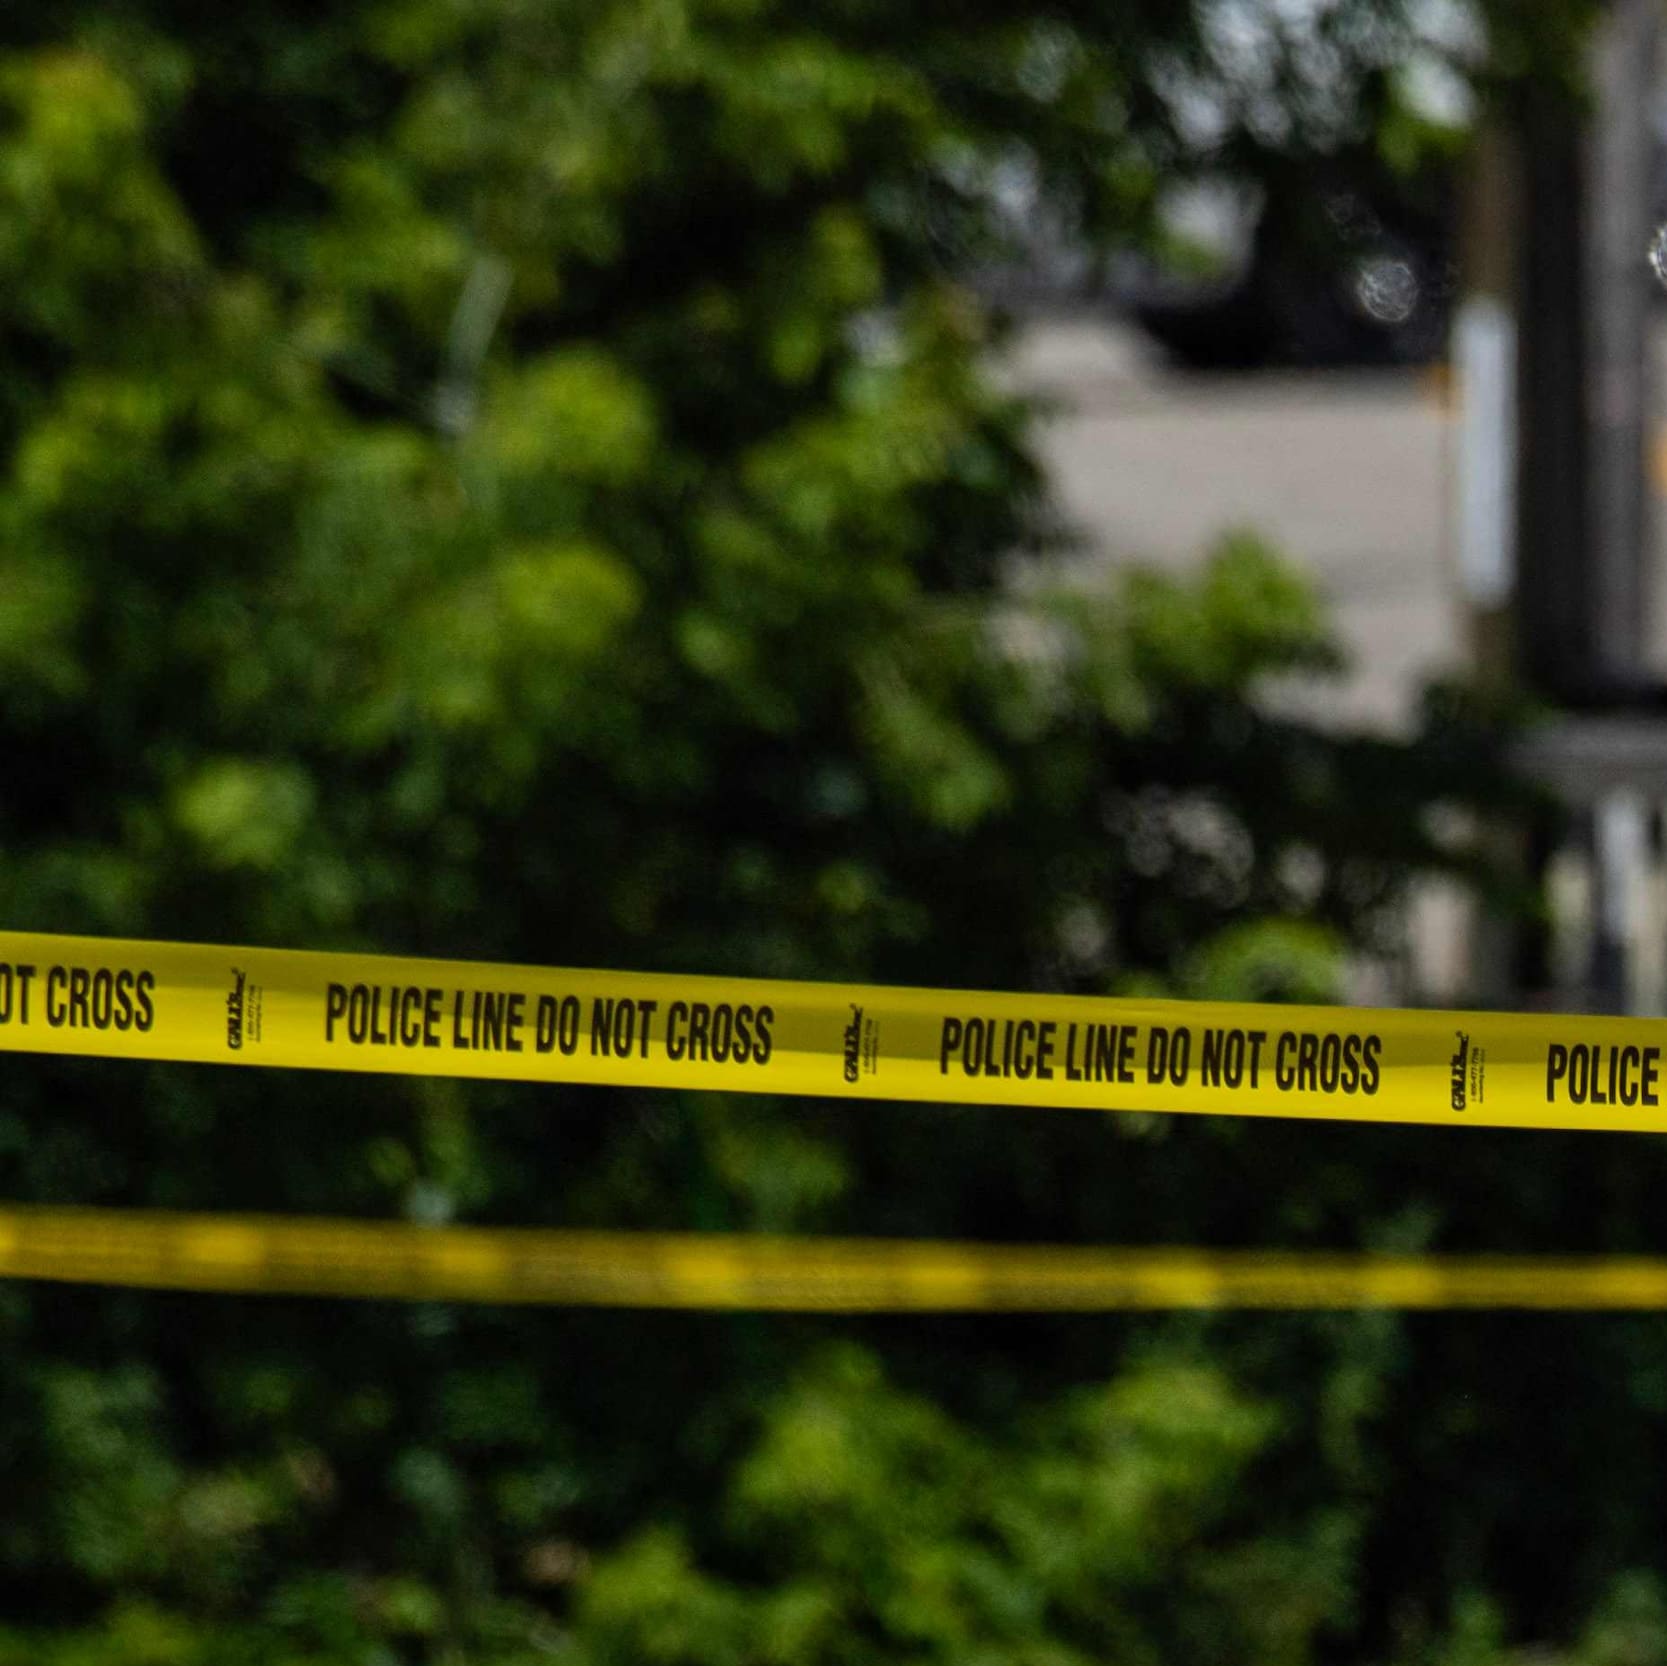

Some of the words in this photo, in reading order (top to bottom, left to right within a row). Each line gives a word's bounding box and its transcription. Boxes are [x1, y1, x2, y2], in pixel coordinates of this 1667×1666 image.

[0, 963, 36, 1024] OT
[47, 966, 154, 1032] CROSS
[326, 983, 443, 1047] POLICE
[454, 991, 525, 1051] LINE
[536, 995, 580, 1056] DO
[591, 998, 657, 1058] NOT
[666, 1001, 773, 1065] CROSS
[941, 1018, 1056, 1079] POLICE
[1066, 1023, 1137, 1083] LINE
[1147, 1027, 1190, 1086] DO
[1202, 1029, 1266, 1088] NOT
[1276, 1032, 1381, 1095] CROSS
[1547, 1044, 1660, 1106] POLICE
